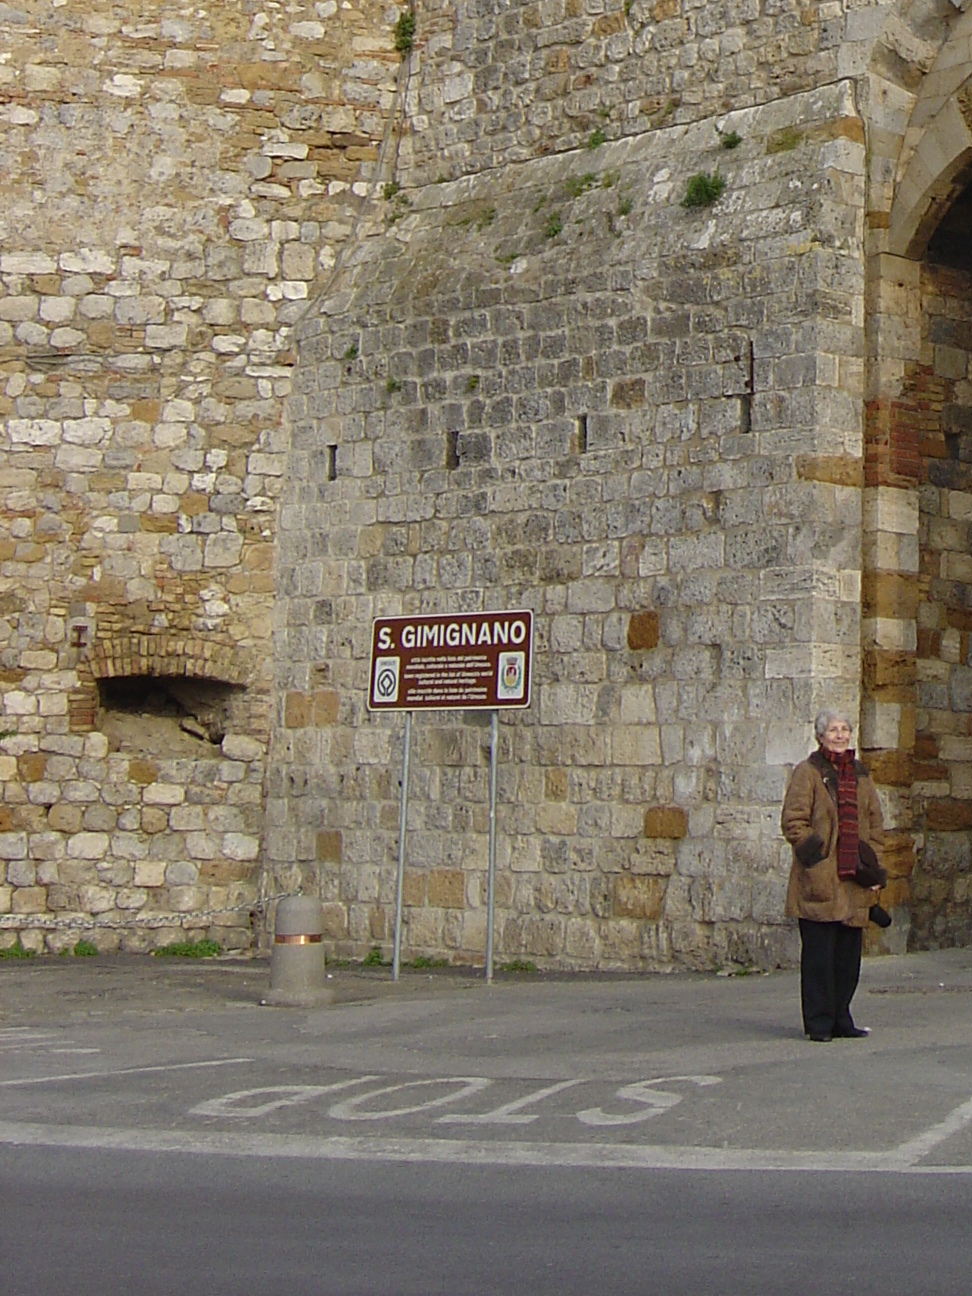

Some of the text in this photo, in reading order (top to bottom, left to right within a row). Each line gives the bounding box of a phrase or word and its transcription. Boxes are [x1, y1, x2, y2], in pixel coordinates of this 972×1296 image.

[377, 620, 526, 650] S. GIMIGNANO
[188, 1075, 724, 1125] STOP
